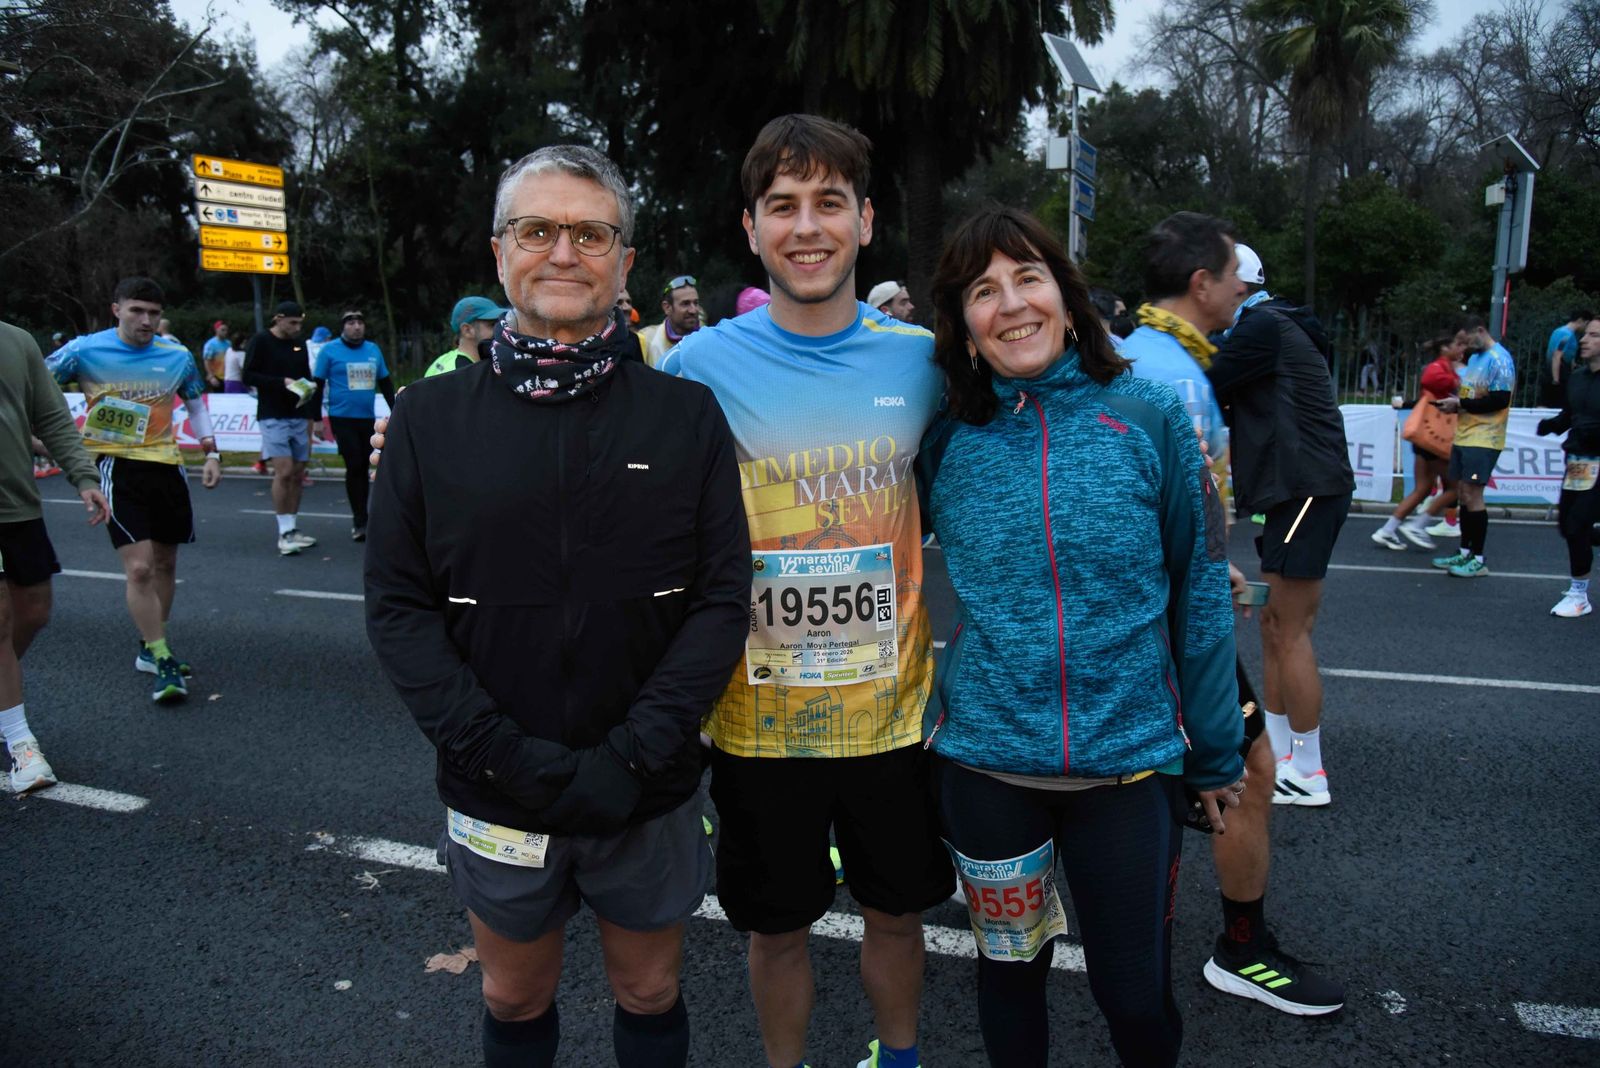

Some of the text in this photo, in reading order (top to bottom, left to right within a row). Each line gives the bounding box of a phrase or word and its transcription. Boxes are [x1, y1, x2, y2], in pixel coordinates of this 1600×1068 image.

[874, 396, 905, 406] HOKA
[96, 407, 134, 428] 9319
[766, 434, 896, 483] MEDIO
[794, 552, 850, 565] maratón
[808, 561, 850, 574] sevilla
[758, 582, 875, 627] 19556
[806, 629, 832, 638] Aaron
[780, 642, 803, 650] Aaron
[806, 641, 828, 650] Moya
[800, 672, 822, 680] HOKA
